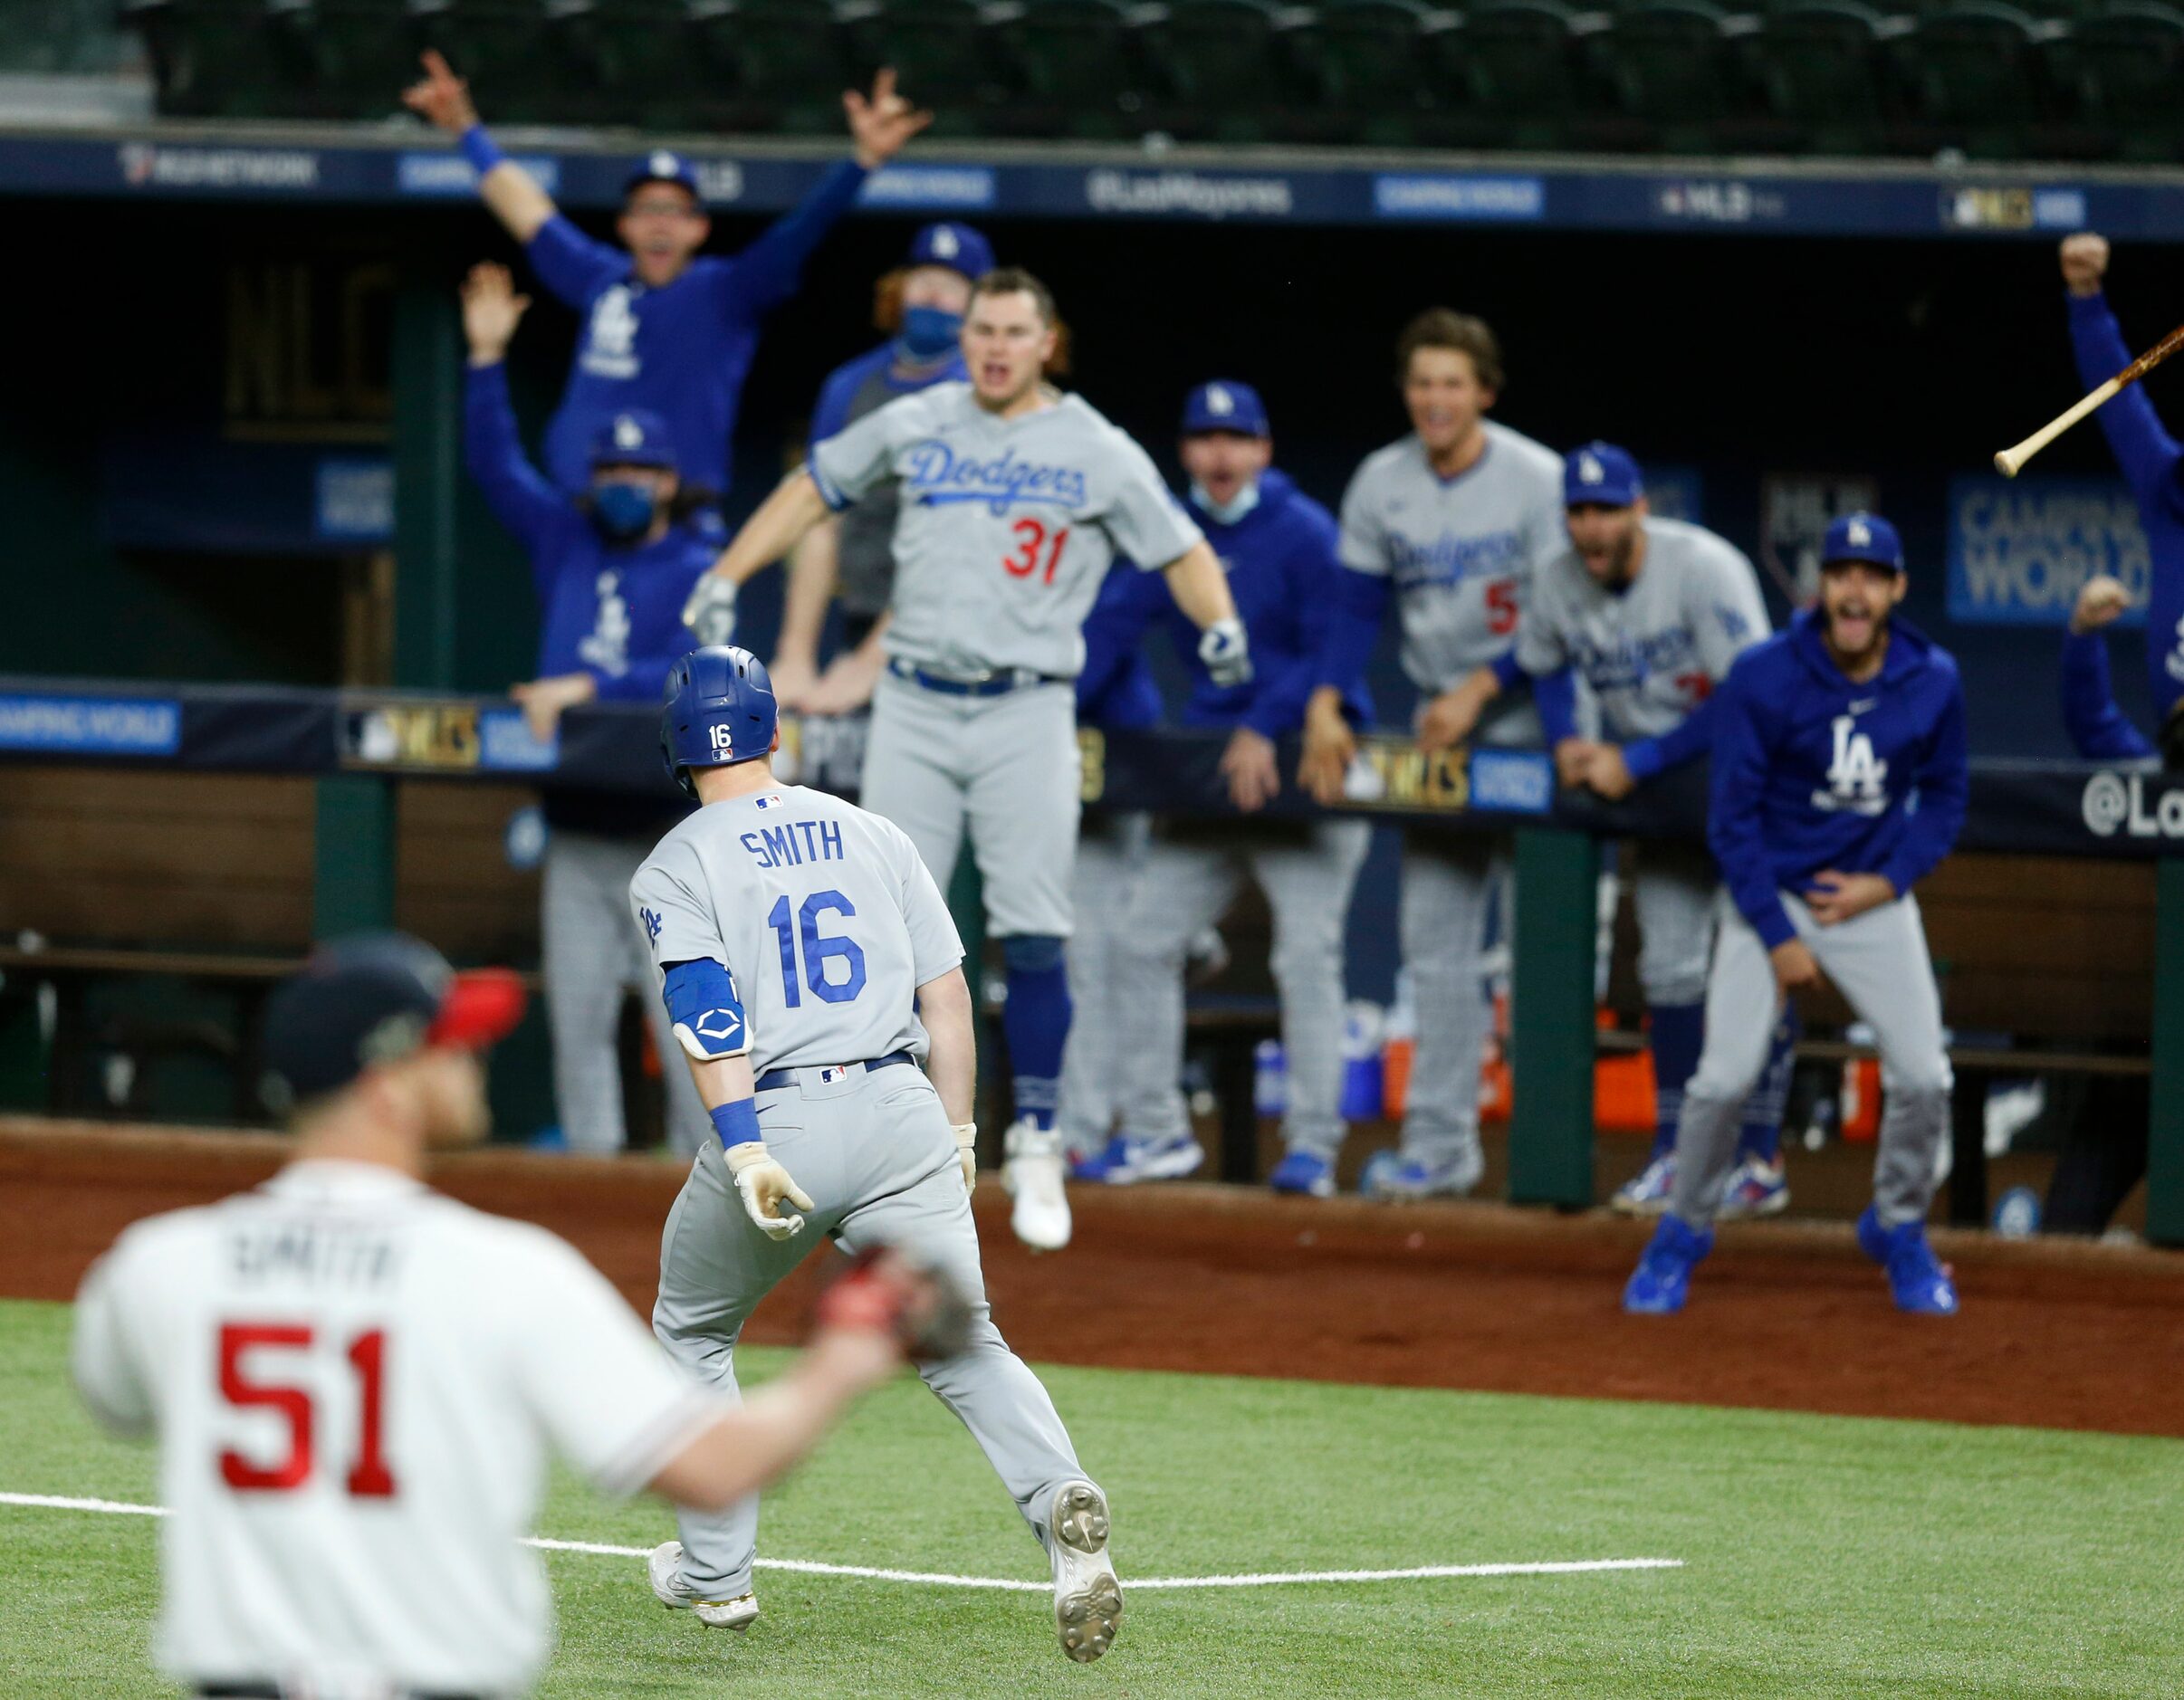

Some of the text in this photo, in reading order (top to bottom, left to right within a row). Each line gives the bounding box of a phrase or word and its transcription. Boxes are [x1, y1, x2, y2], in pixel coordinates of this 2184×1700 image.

[909, 439, 1085, 516] Dodgers
[1003, 514, 1069, 585] 31
[1483, 576, 1520, 636] 5
[708, 724, 732, 750] 16
[740, 820, 844, 868] SMITH
[768, 890, 867, 1008] 16
[220, 1323, 396, 1499] 51
